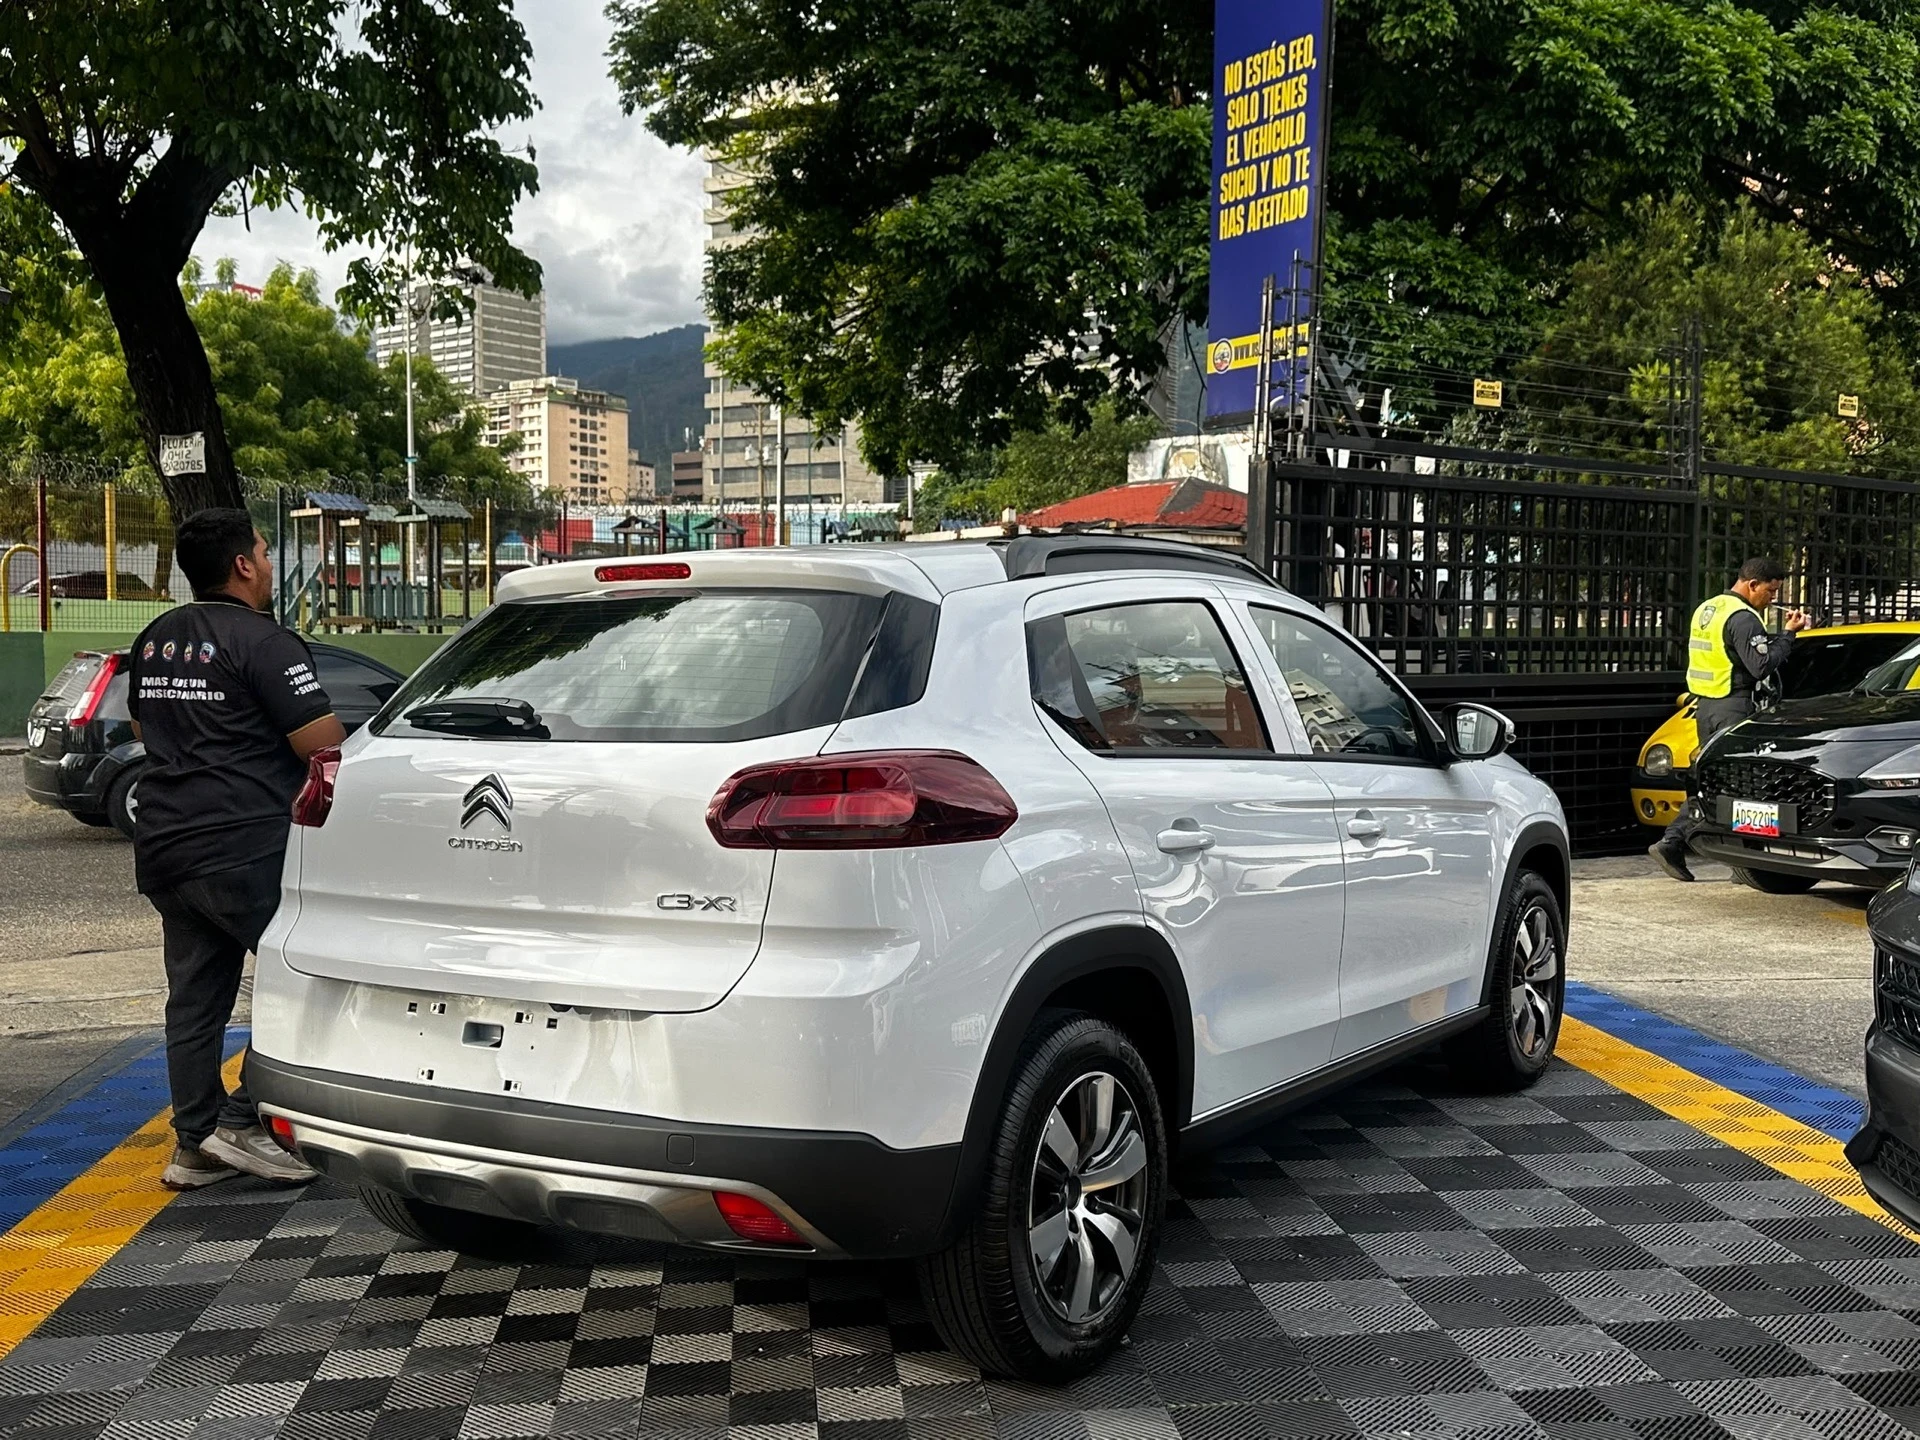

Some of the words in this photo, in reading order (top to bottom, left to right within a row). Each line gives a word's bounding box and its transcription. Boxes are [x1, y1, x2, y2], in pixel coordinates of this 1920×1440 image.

[1224, 60, 1243, 97] NO
[1245, 40, 1286, 89] ESTÁS
[1288, 33, 1317, 73] FEO,
[1226, 91, 1259, 131] SOLO
[1262, 73, 1308, 119] TIENES
[1226, 133, 1240, 168] EL
[1243, 112, 1306, 162] VEHÍCULO
[1220, 164, 1258, 205] SUCIO
[1260, 159, 1270, 193] Y
[1272, 153, 1292, 189] NO
[1294, 146, 1311, 182] TE
[1219, 204, 1245, 241] HAS
[1246, 185, 1309, 233] AFEITADO
[162, 460, 203, 472] 2020785
[167, 450, 192, 460] 0412
[141, 676, 169, 687] MAS
[189, 678, 207, 689] UN
[283, 662, 308, 676] +DIOS
[656, 892, 736, 912] C3-XR
